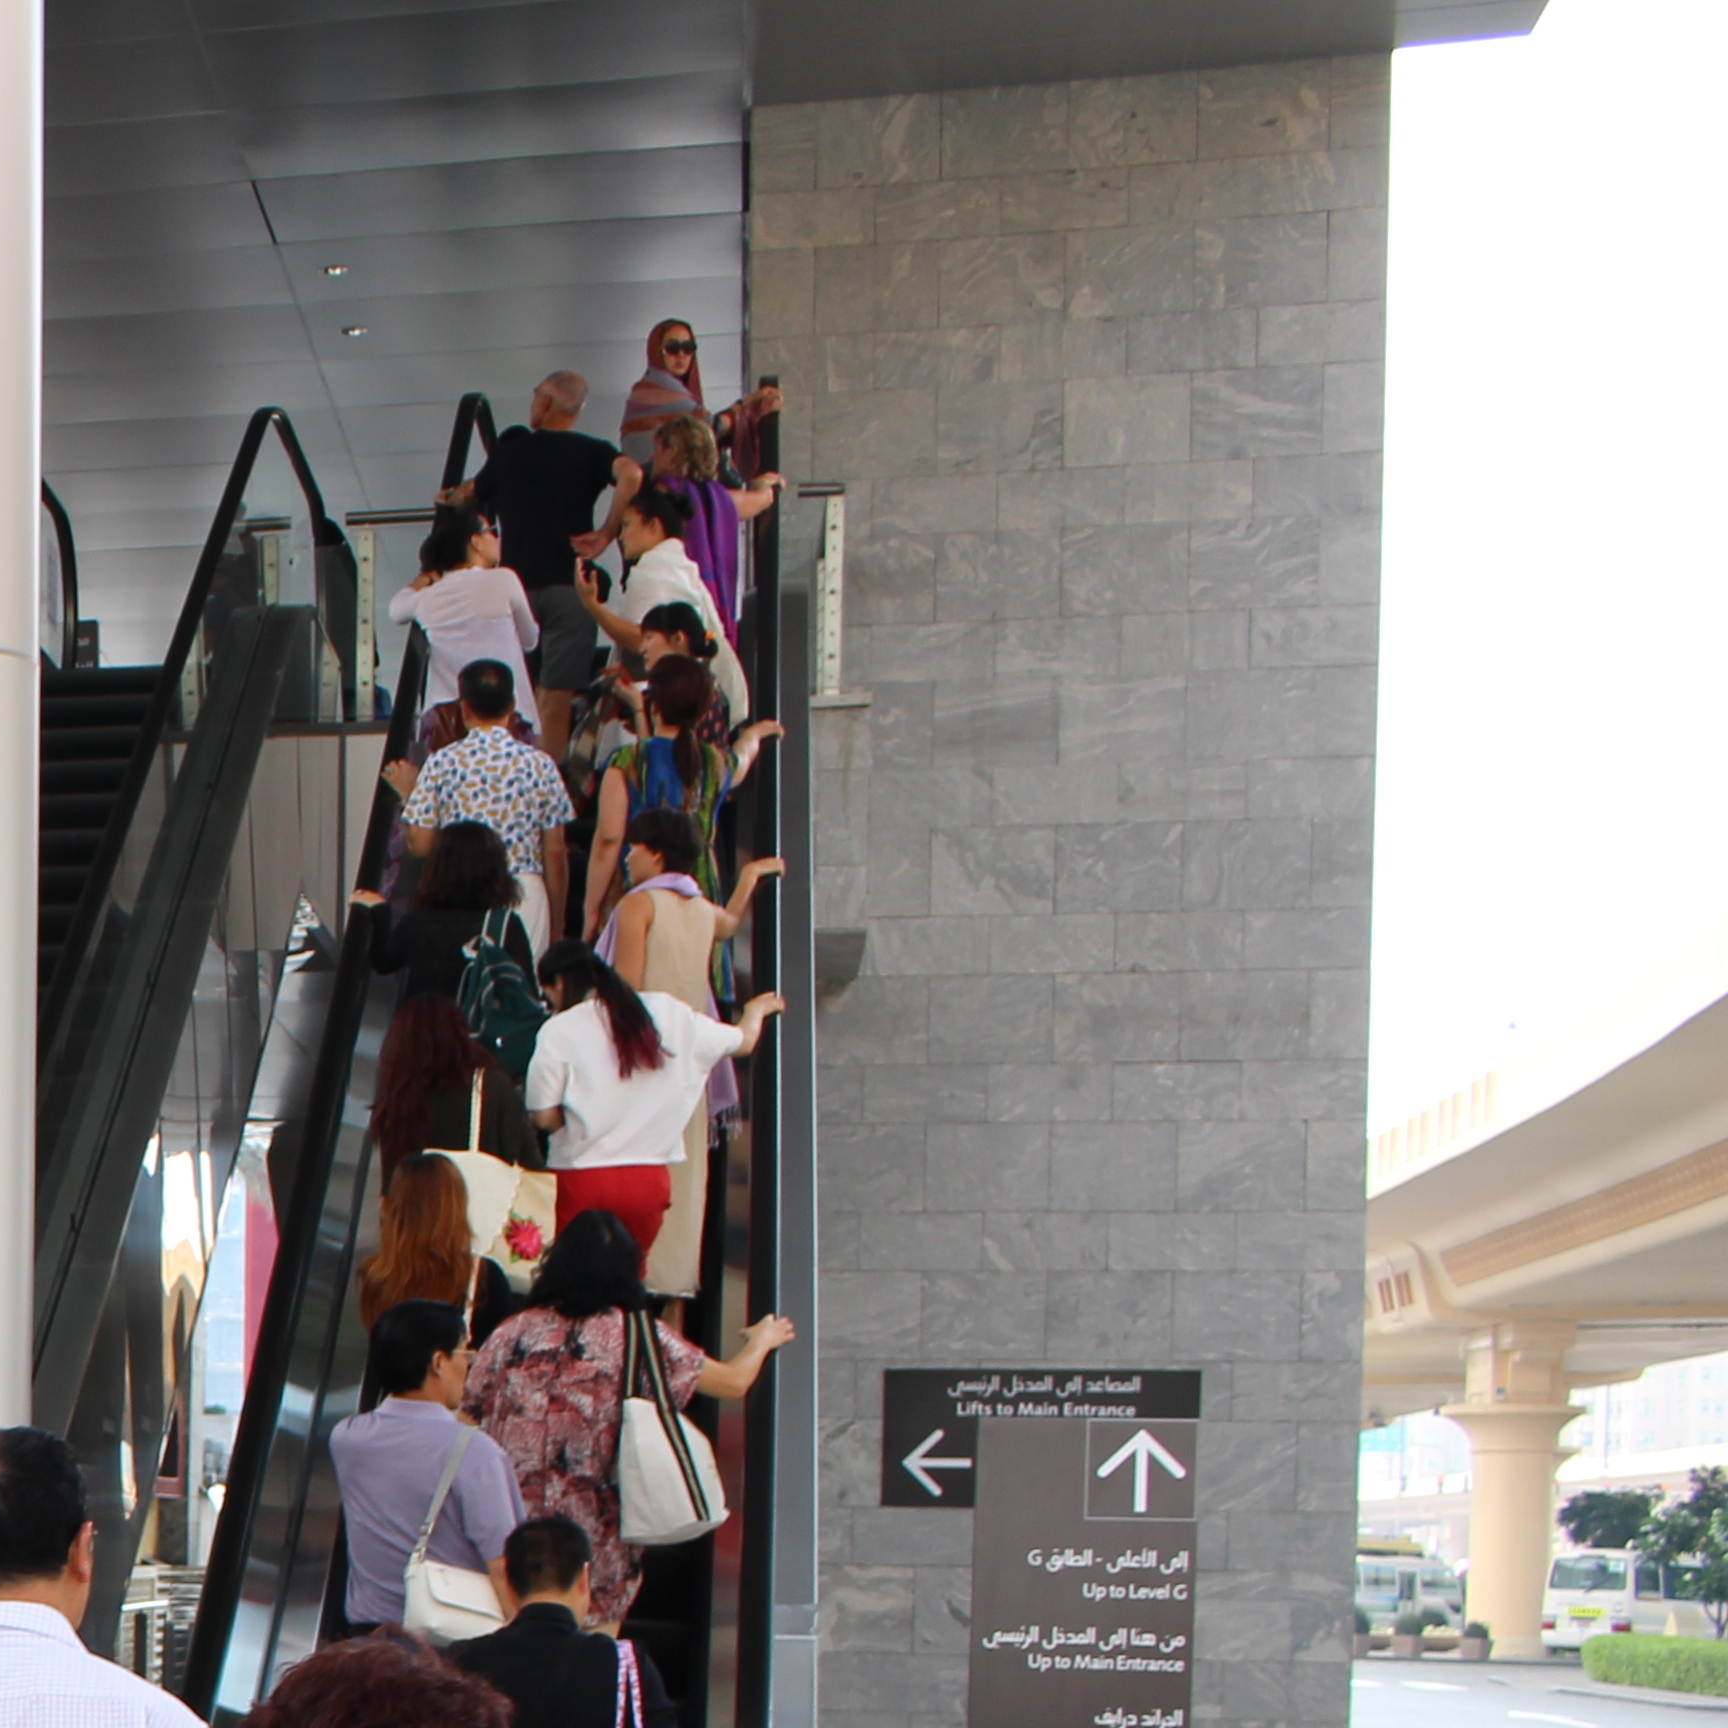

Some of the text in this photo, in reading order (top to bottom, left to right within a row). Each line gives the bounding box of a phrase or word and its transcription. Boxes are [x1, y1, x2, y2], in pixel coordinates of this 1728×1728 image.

[1002, 1375, 1054, 1398] المدخل
[1055, 1375, 1083, 1398] إلى
[1085, 1375, 1142, 1394] المصاعد
[956, 1401, 1137, 1417] Lifts to Main Entrance
[1027, 1549, 1043, 1566] G
[1045, 1548, 1093, 1572] الطابق
[1105, 1547, 1158, 1574] الأعلى
[1159, 1550, 1189, 1575] إلى
[1081, 1582, 1188, 1601] Up to Level G
[982, 1624, 1187, 1653] من هنا إلى المدخل الرئيسي
[1027, 1653, 1185, 1672] Up to Main Entrance
